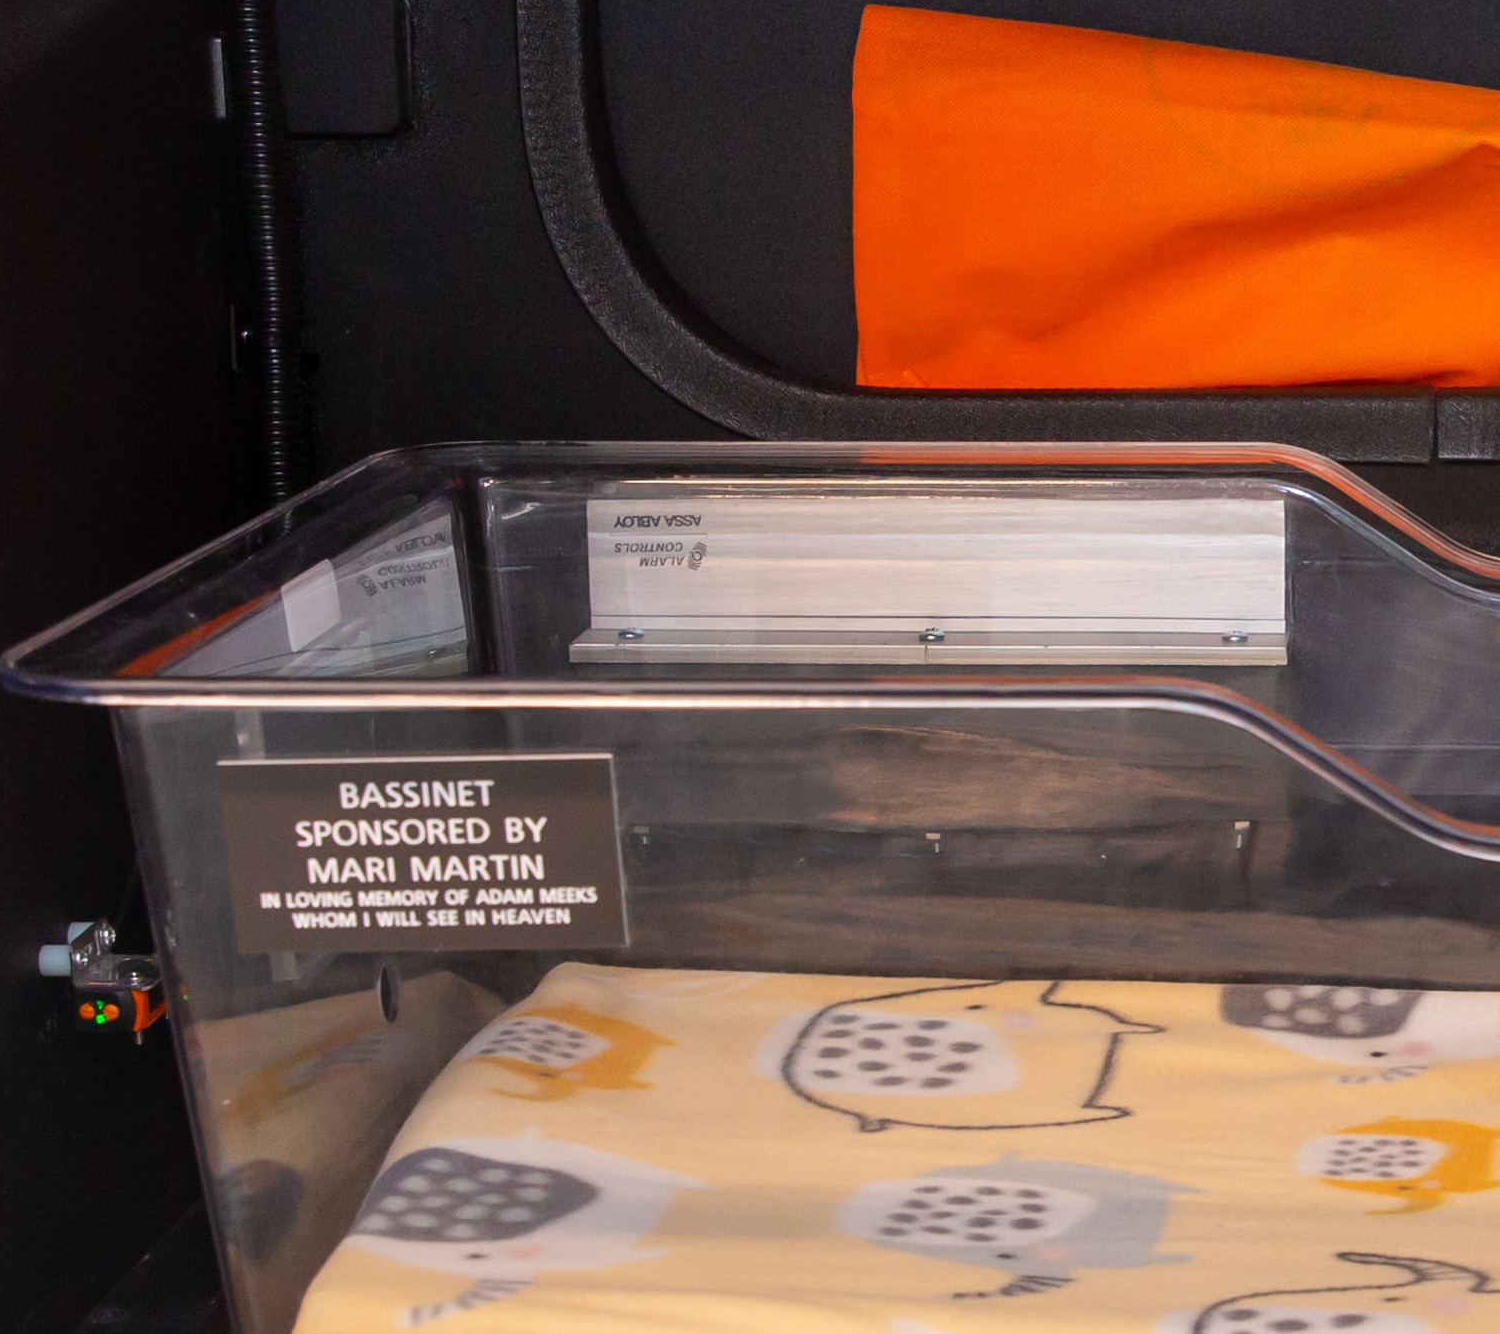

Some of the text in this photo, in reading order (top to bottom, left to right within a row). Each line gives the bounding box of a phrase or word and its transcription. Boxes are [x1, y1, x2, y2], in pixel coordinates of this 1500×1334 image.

[613, 514, 702, 529] ASSA ABLOY
[613, 541, 684, 554] CONTROLS
[639, 555, 686, 567] ALARM
[339, 779, 495, 810] BASSINET
[294, 816, 548, 848] SPONSORED BY
[307, 854, 545, 884] MARI MARTIN
[260, 886, 598, 909] IN LOVING MEMORY OF ADAM MEEKS
[291, 907, 572, 929] WHOM I WILL SEE IN HEAVEN
